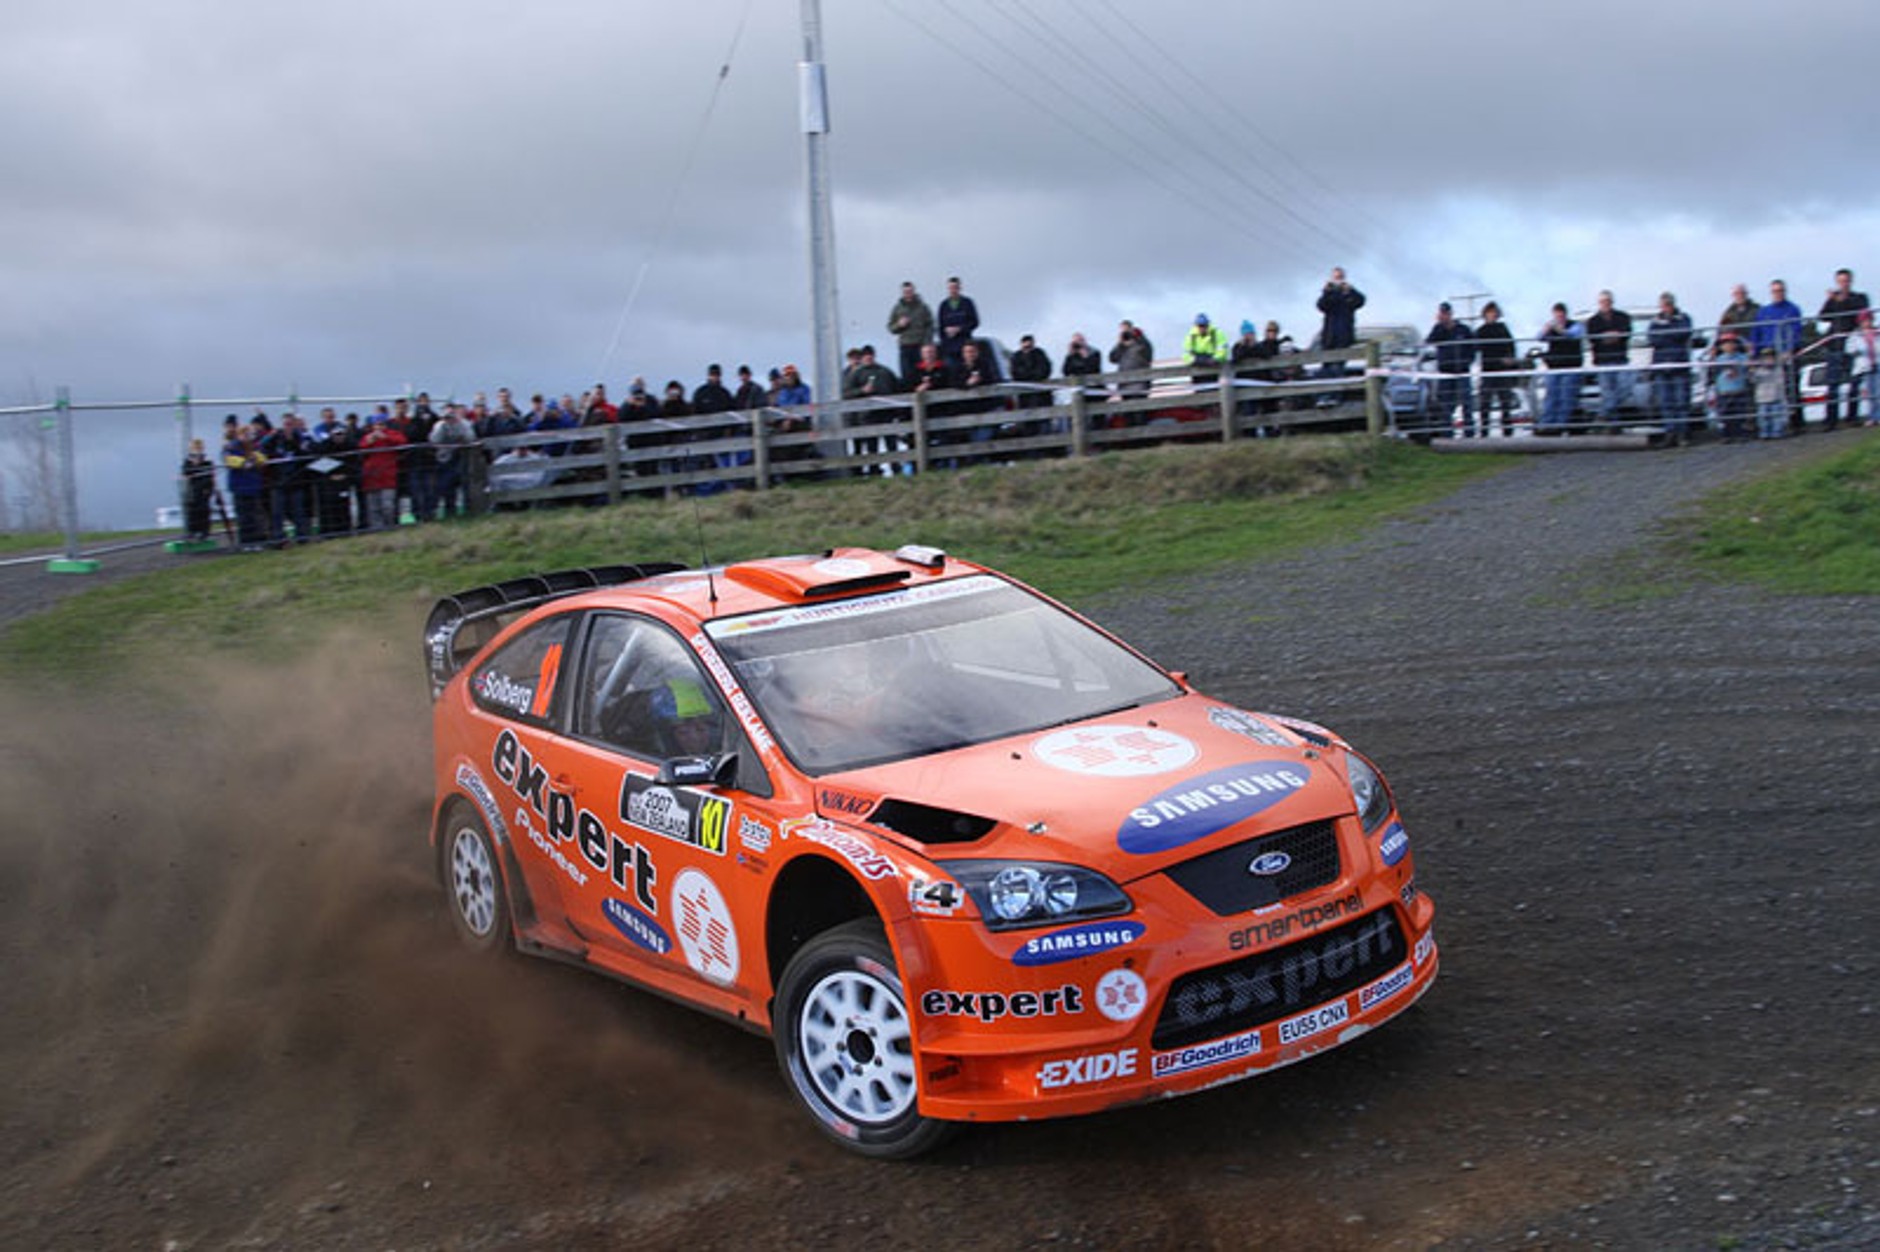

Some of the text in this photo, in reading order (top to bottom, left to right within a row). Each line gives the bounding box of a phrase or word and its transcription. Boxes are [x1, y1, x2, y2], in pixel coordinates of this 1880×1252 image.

[483, 671, 533, 714] Solberg
[644, 791, 673, 812] 2007
[1130, 768, 1306, 829] SAMSUNG
[492, 729, 658, 915] expert
[702, 798, 722, 850] 10
[515, 807, 589, 886] Pioneer
[608, 895, 666, 953] SAMSUNG
[1026, 928, 1133, 954] SAMSUNG
[1229, 895, 1365, 950] smartpanel
[1176, 905, 1393, 1026] expert
[1362, 964, 1413, 1003] BFGoodrich
[921, 984, 1083, 1022] expert
[1319, 1002, 1346, 1027] CNX
[1036, 1048, 1139, 1088] EXIDE
[1155, 1032, 1260, 1071] BFGoodrich
